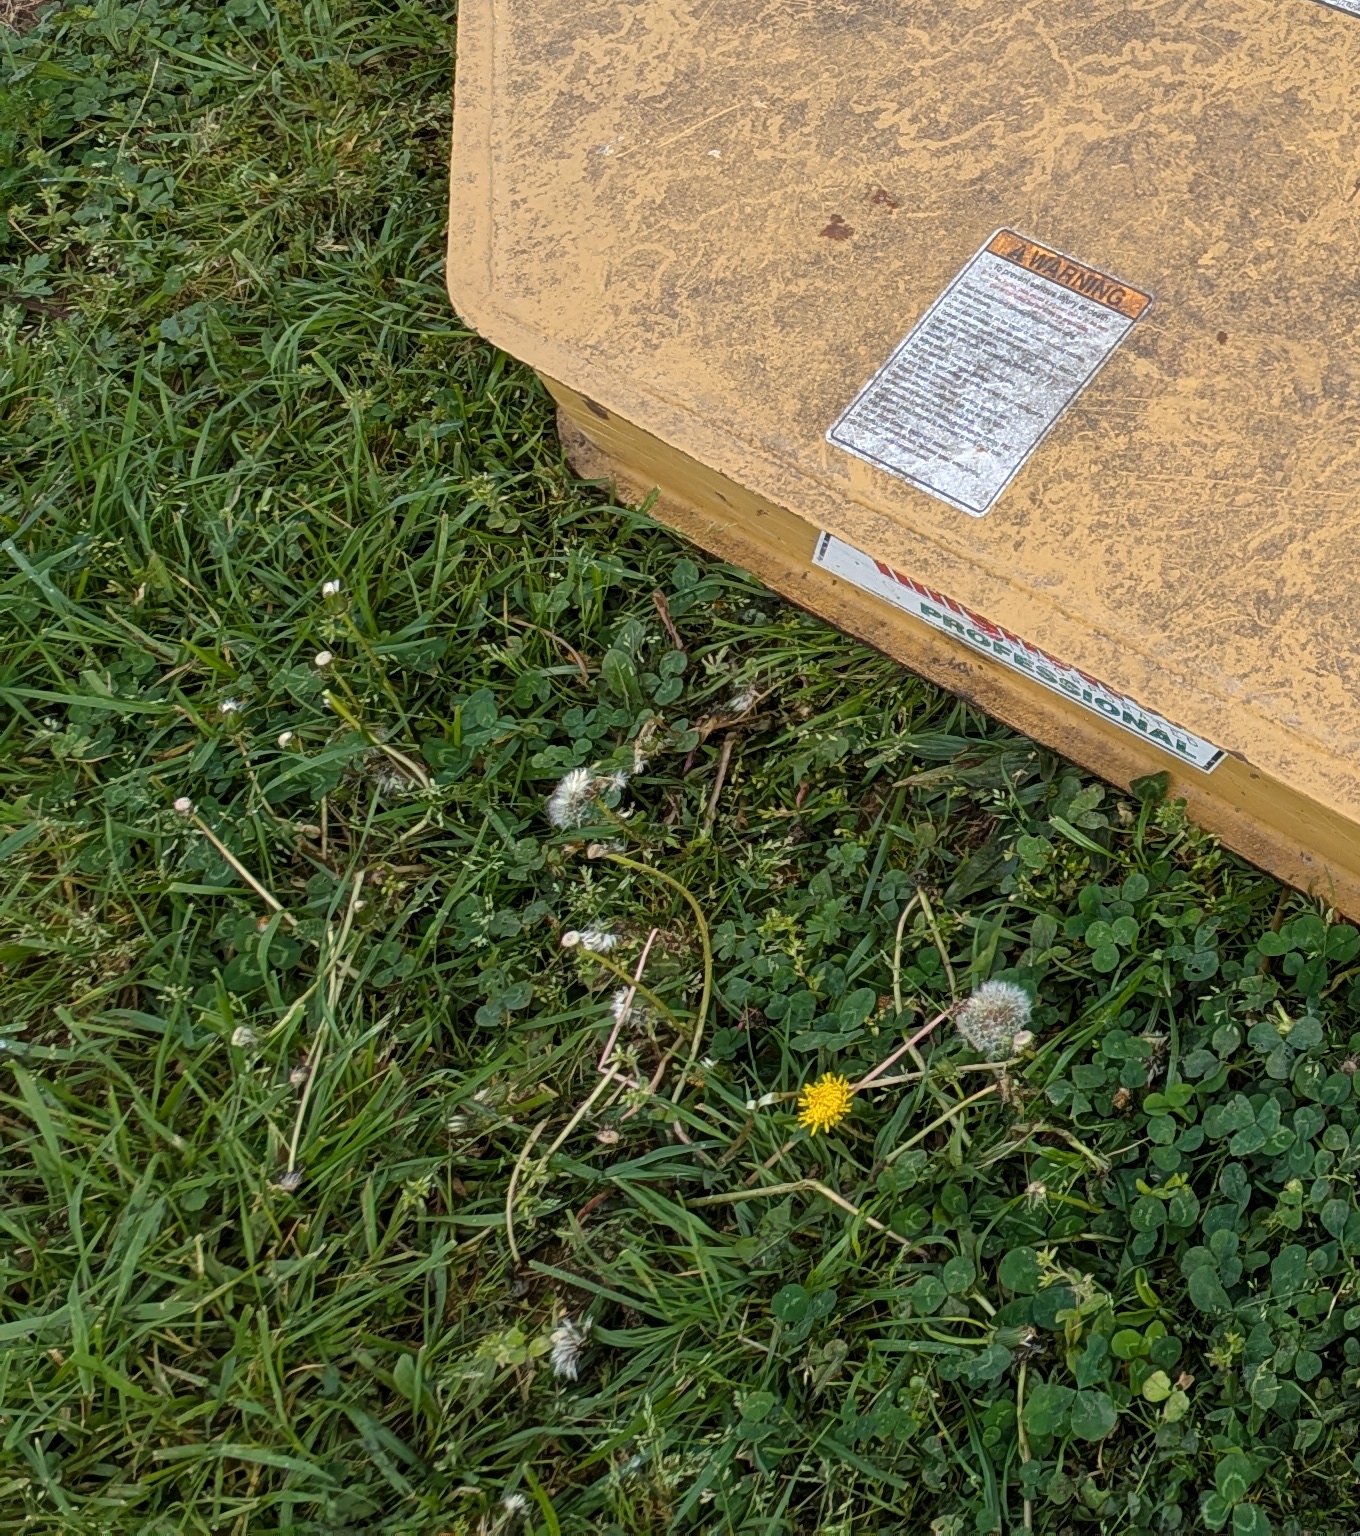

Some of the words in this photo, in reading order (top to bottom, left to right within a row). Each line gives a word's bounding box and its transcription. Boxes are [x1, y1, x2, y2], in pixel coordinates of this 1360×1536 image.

[993, 263, 1004, 271] To
[1002, 267, 1030, 285] prevent
[1030, 281, 1056, 297] serious
[1055, 293, 1079, 308] injury
[1027, 252, 1127, 306] WARNING
[918, 602, 1200, 757] PROFESSIONAL
